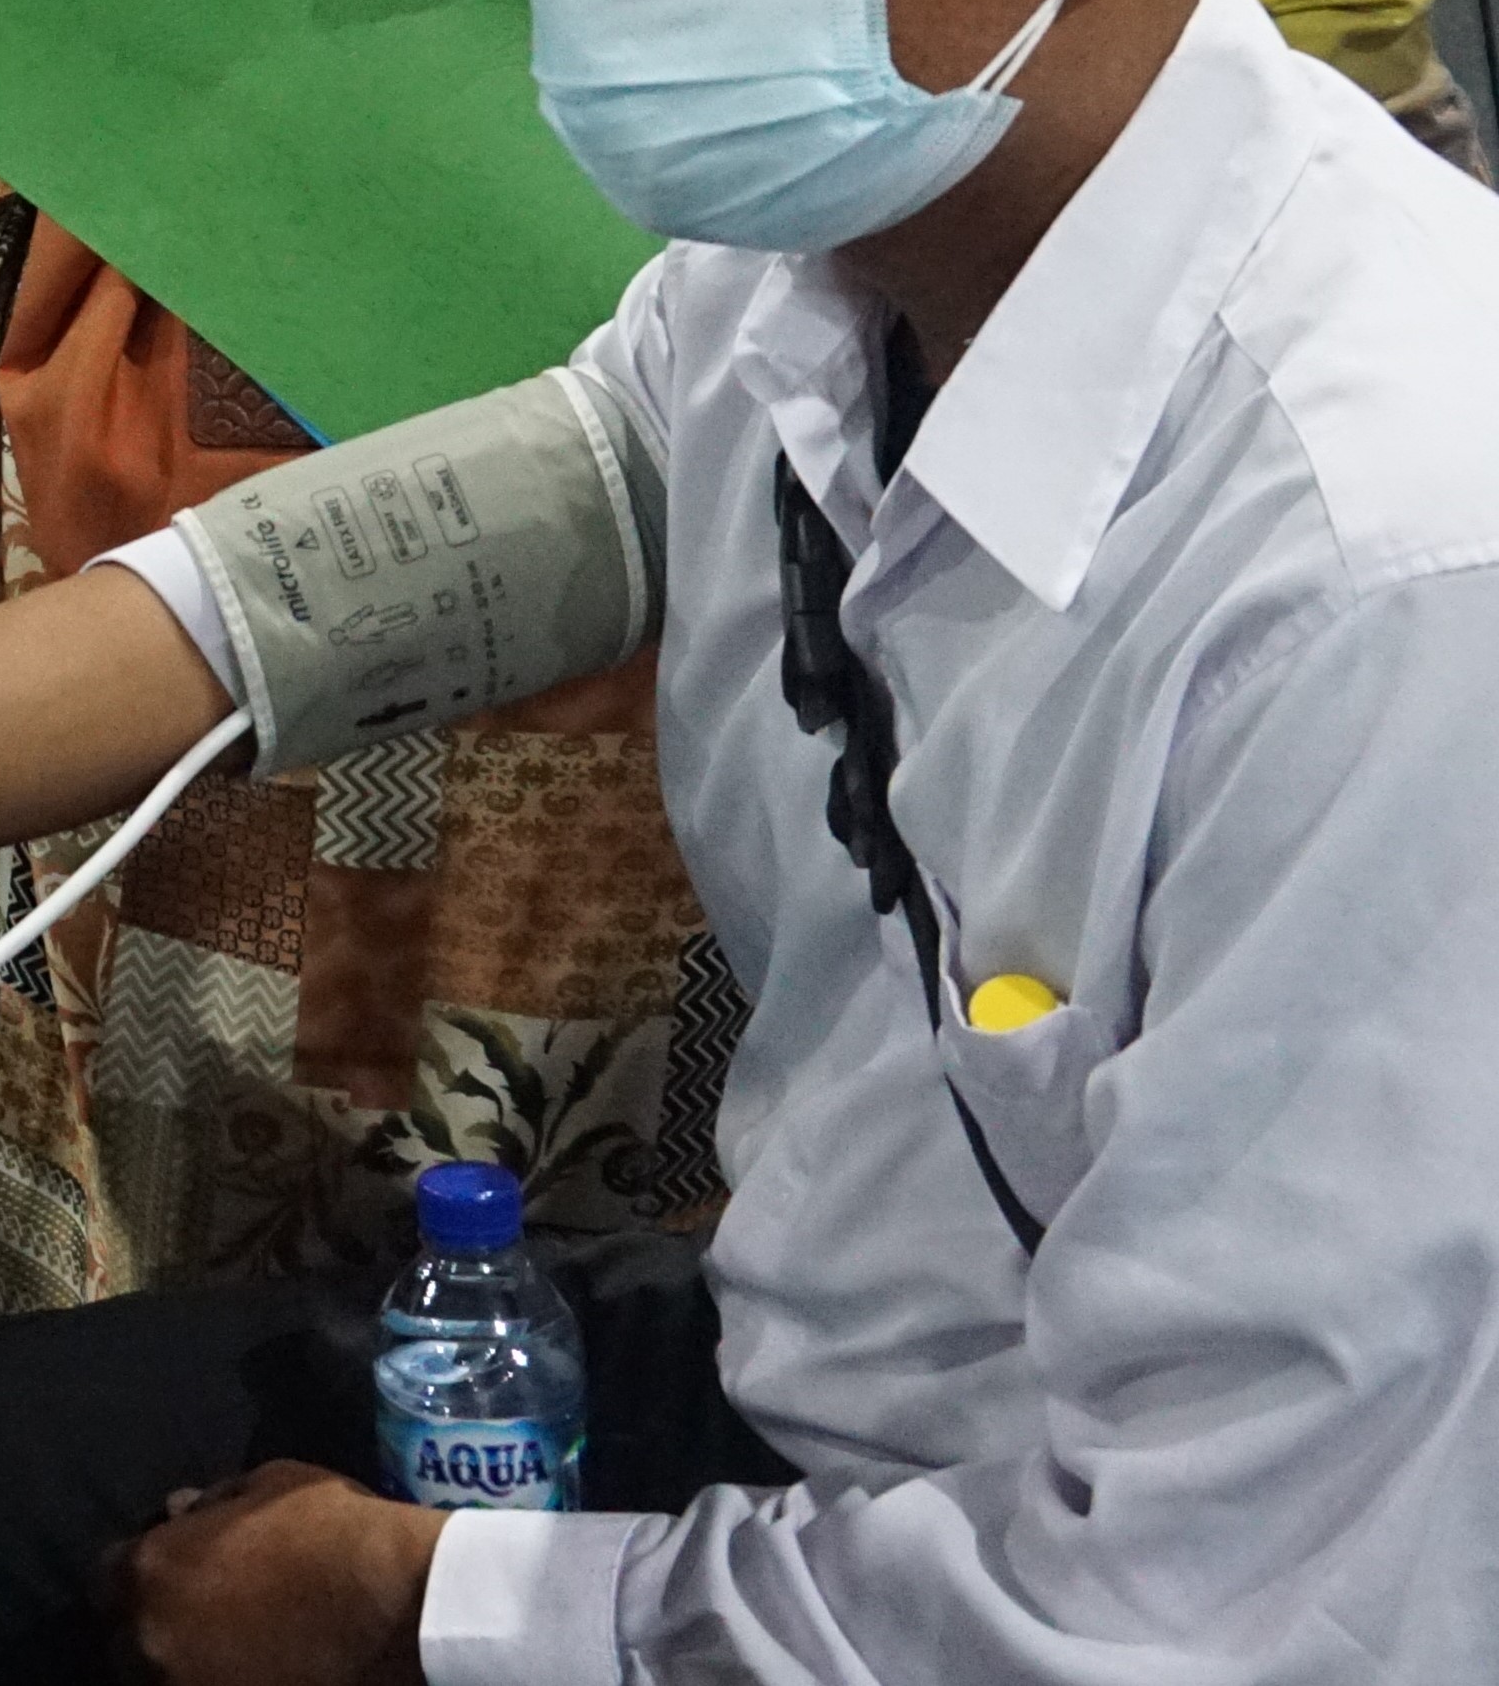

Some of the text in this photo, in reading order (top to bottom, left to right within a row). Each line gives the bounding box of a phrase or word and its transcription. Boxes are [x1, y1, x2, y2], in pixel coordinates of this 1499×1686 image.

[245, 519, 312, 623] microlife
[338, 527, 365, 569] LATEX
[416, 1437, 548, 1498] AQUA
